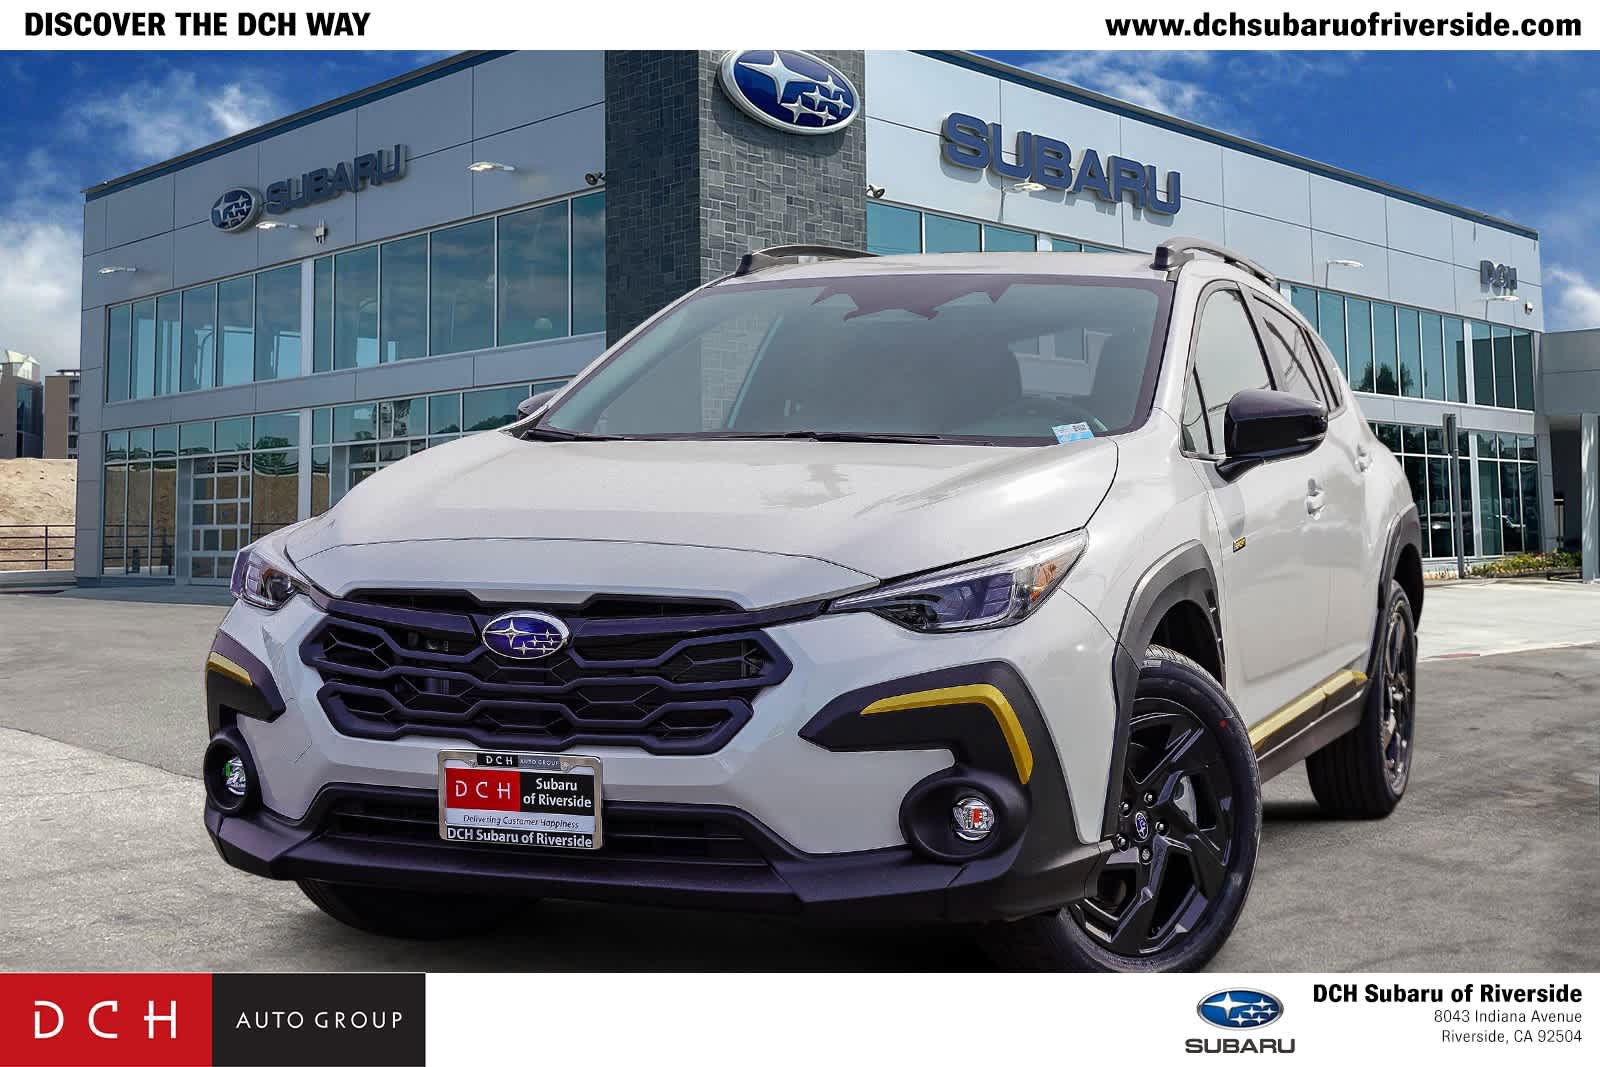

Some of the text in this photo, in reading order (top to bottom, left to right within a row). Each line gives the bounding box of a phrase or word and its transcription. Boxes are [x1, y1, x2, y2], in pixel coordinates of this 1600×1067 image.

[940, 112, 1181, 216] SUBARU
[266, 144, 407, 215] SUBARU
[485, 755, 513, 766] DCH
[455, 780, 511, 800] DCH
[535, 777, 578, 791] Subaru
[523, 793, 592, 808] of Riverside
[463, 814, 579, 829] Delivering Customer Happiness
[447, 827, 593, 848] DCH Subaru of Riverside
